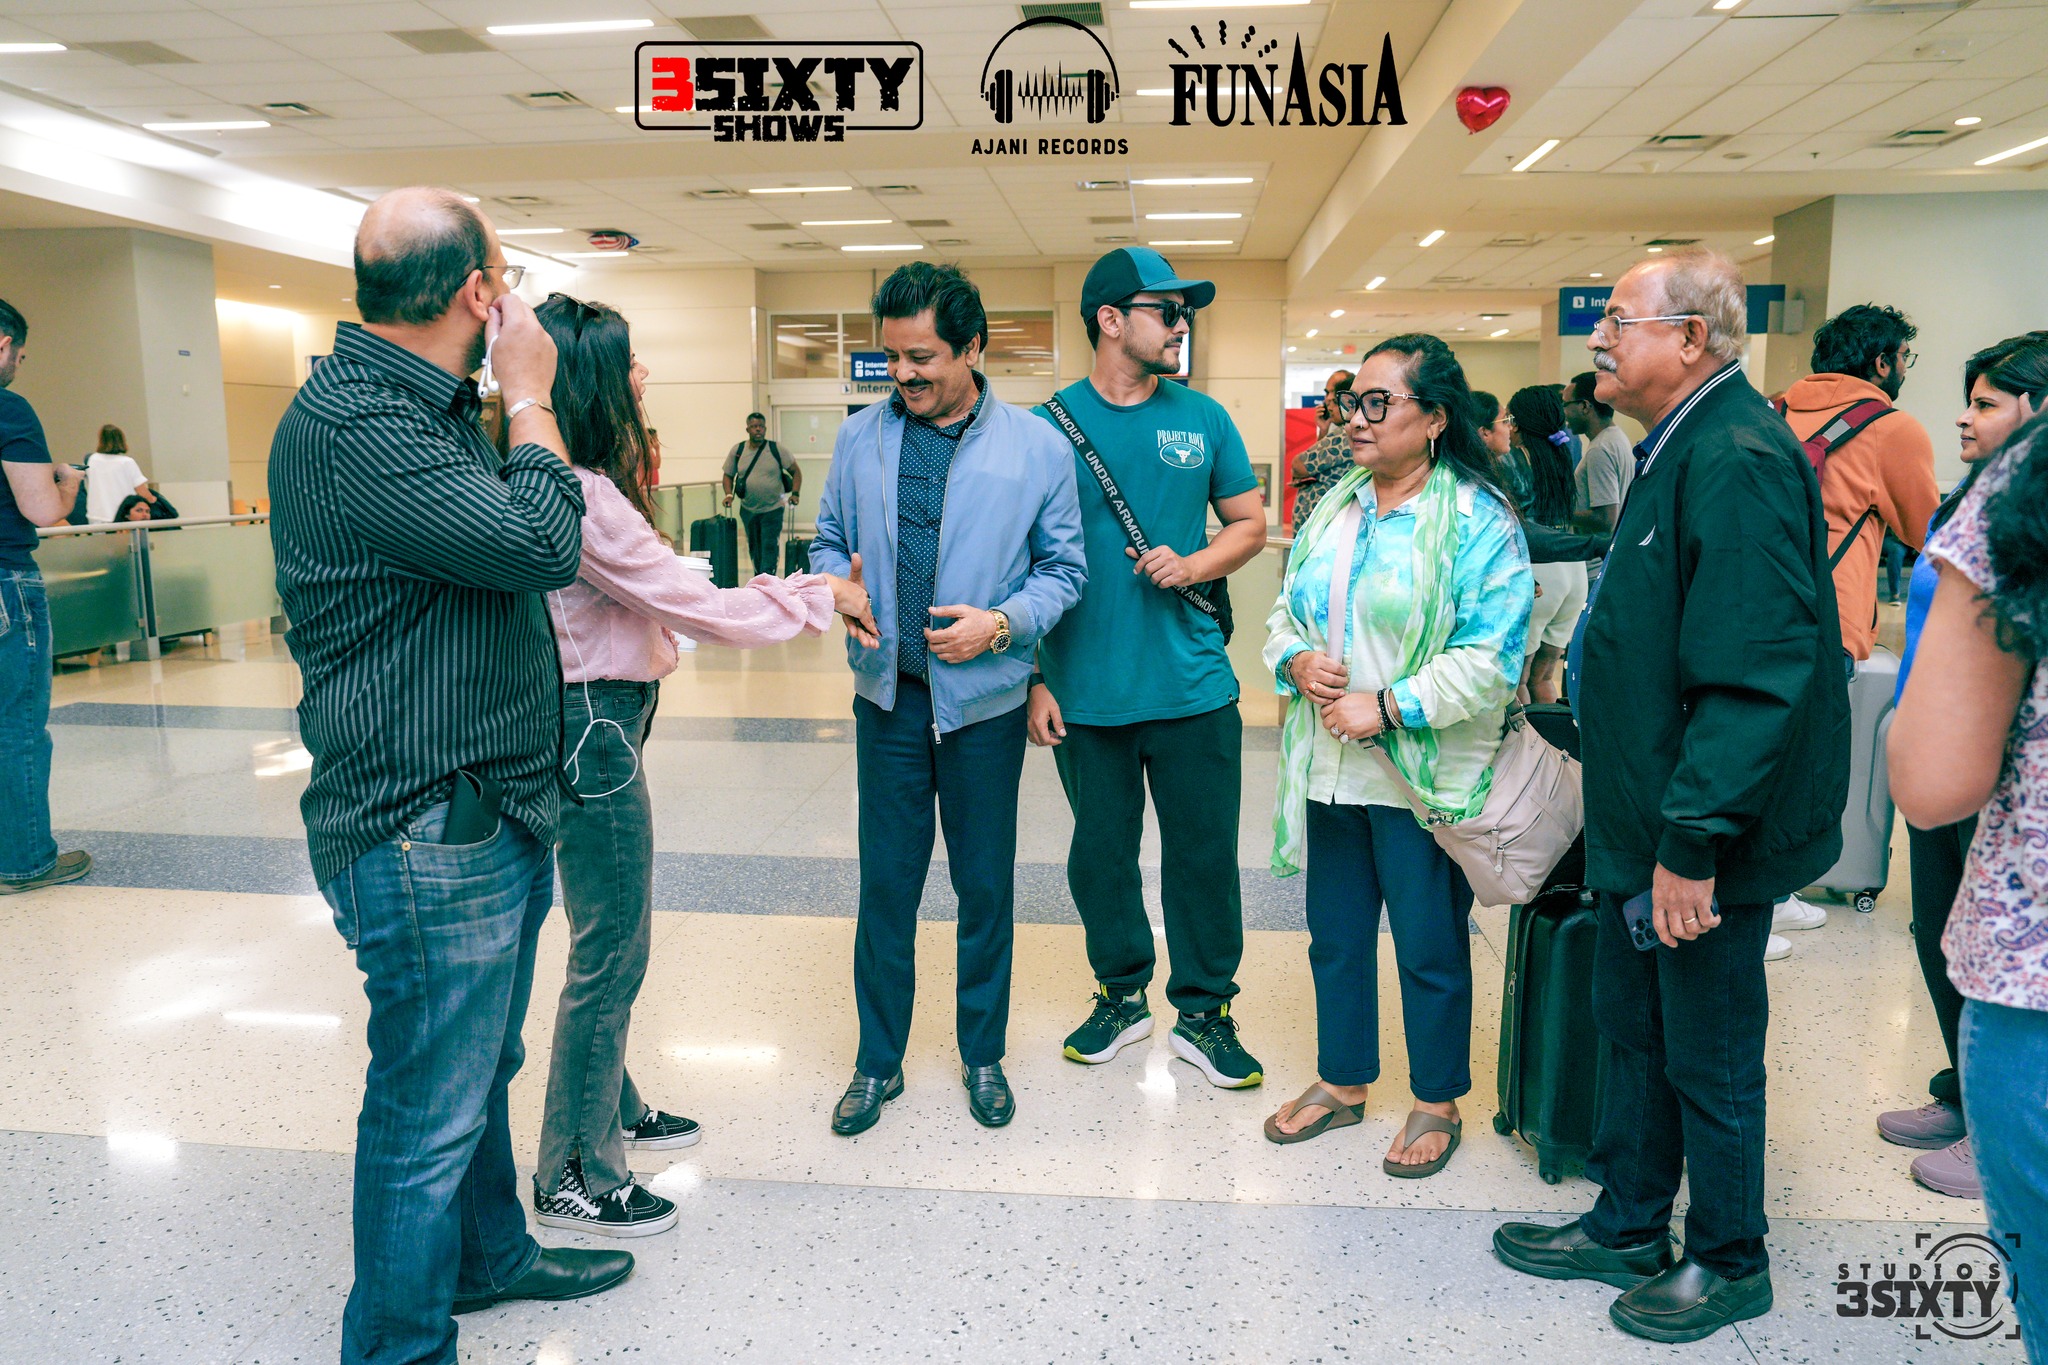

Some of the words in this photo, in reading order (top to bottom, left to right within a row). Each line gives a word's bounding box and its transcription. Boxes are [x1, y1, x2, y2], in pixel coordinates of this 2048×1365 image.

[1046, 401, 1086, 446] ARMOUR
[1085, 450, 1118, 498] UNDER
[1156, 429, 1187, 449] PROJECT
[1188, 431, 1205, 454] ROCK
